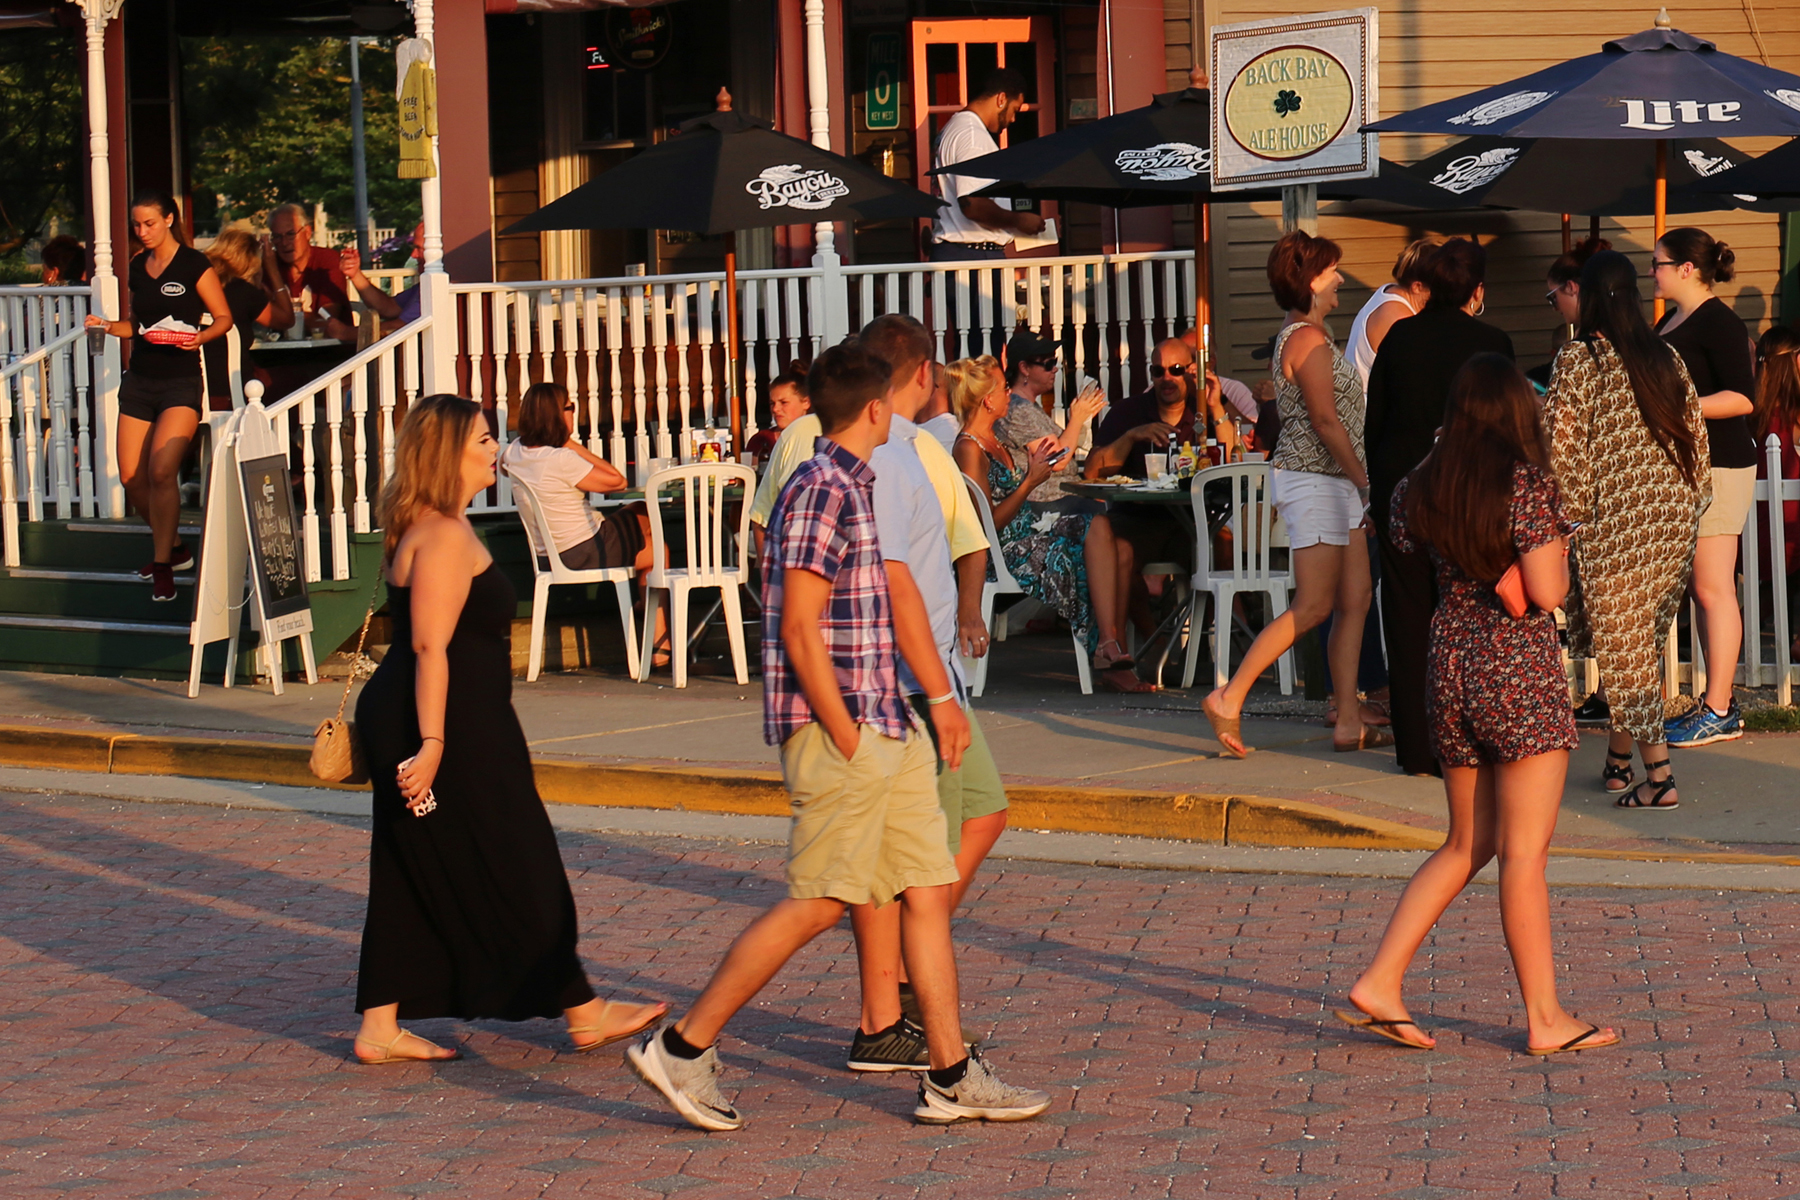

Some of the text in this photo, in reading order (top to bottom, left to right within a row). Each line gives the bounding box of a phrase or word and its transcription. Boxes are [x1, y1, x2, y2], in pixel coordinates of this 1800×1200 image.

[869, 40, 897, 65] MILE
[1245, 56, 1331, 87] BACK BAY
[403, 96, 418, 108] FREE
[871, 110, 895, 122] KEY WEST
[1619, 100, 1742, 131] Lite
[1249, 122, 1330, 151] ALE HOUSE
[745, 171, 840, 210] Bayou
